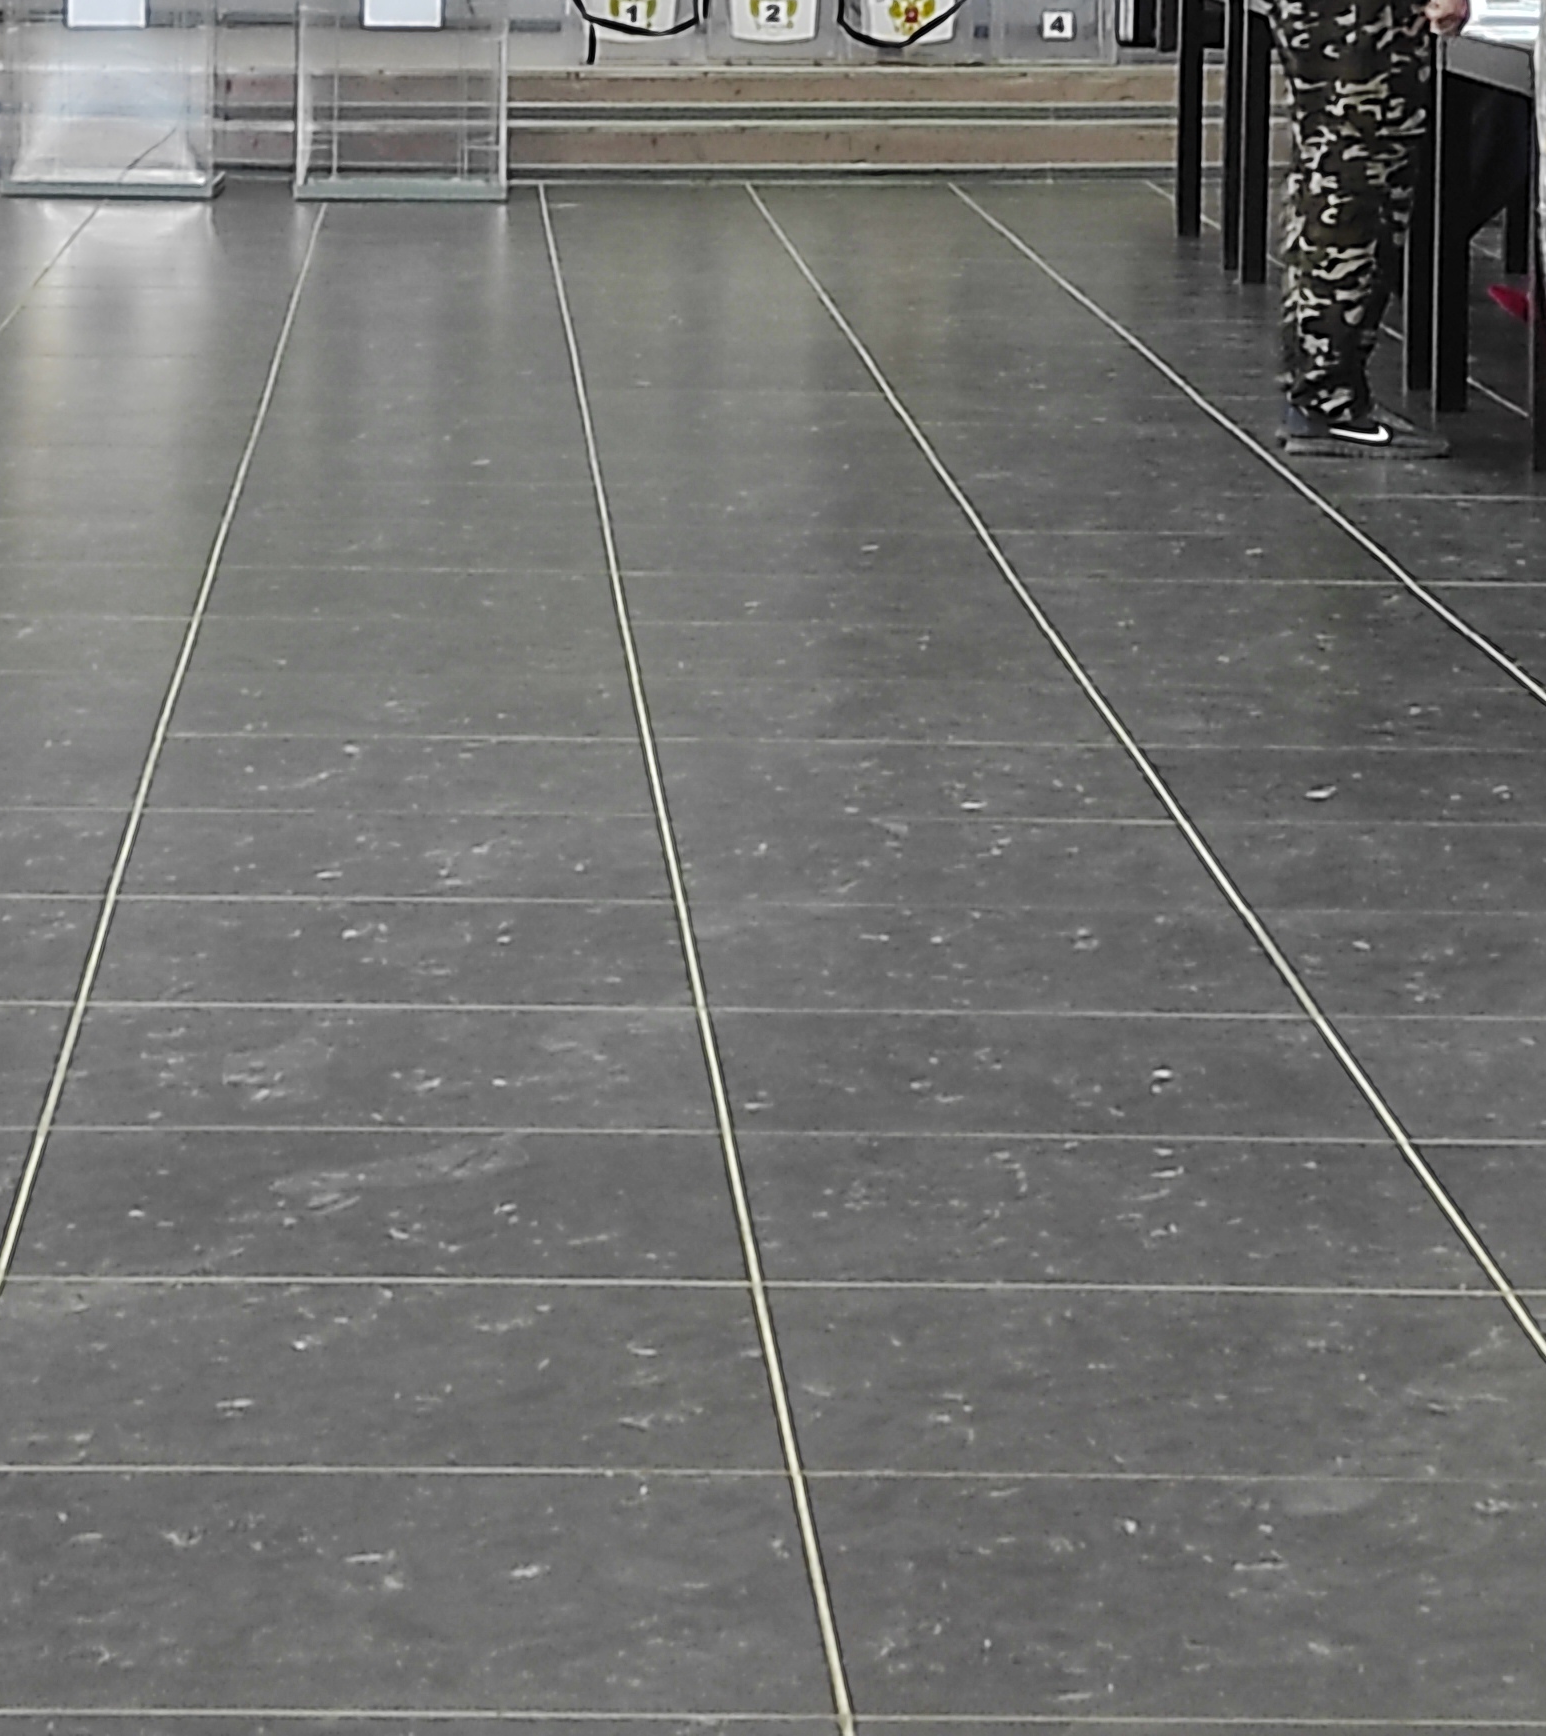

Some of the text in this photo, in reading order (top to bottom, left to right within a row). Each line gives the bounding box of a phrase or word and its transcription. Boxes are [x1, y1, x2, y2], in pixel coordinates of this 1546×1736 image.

[626, 5, 638, 23] 1
[765, 4, 781, 23] 2
[1050, 15, 1065, 34] 4
